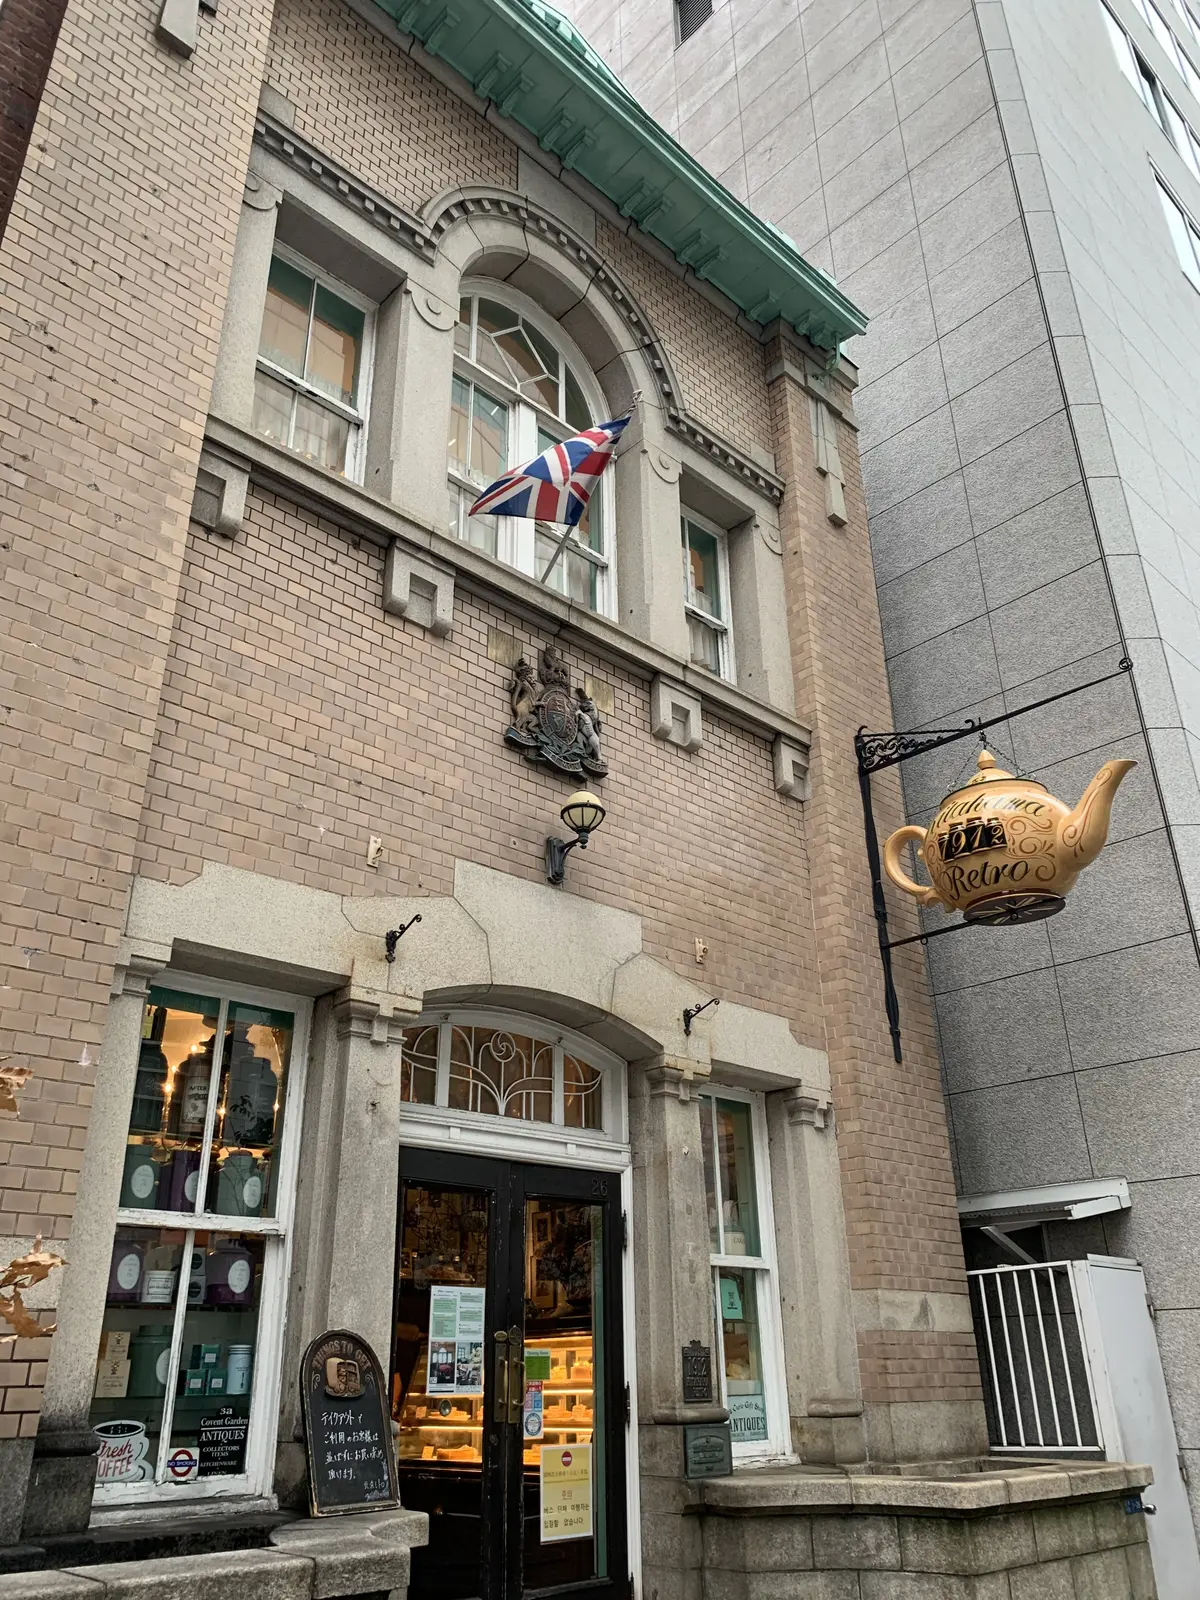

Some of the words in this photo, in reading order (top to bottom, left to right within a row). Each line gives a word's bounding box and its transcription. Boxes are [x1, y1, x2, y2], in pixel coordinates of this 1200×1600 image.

[940, 825, 1004, 861] 1912
[946, 860, 1031, 900] Retro
[591, 1178, 608, 1196] 26
[312, 1340, 341, 1370] THINGS
[341, 1340, 353, 1356] TO
[355, 1349, 372, 1371] GET
[200, 1417, 224, 1426] Covent
[224, 1416, 249, 1426] Garden
[219, 1407, 233, 1415] 3a
[200, 1430, 246, 1443] ANTIQUES
[95, 1438, 134, 1458] Fresh
[97, 1454, 133, 1478] OFFEE
